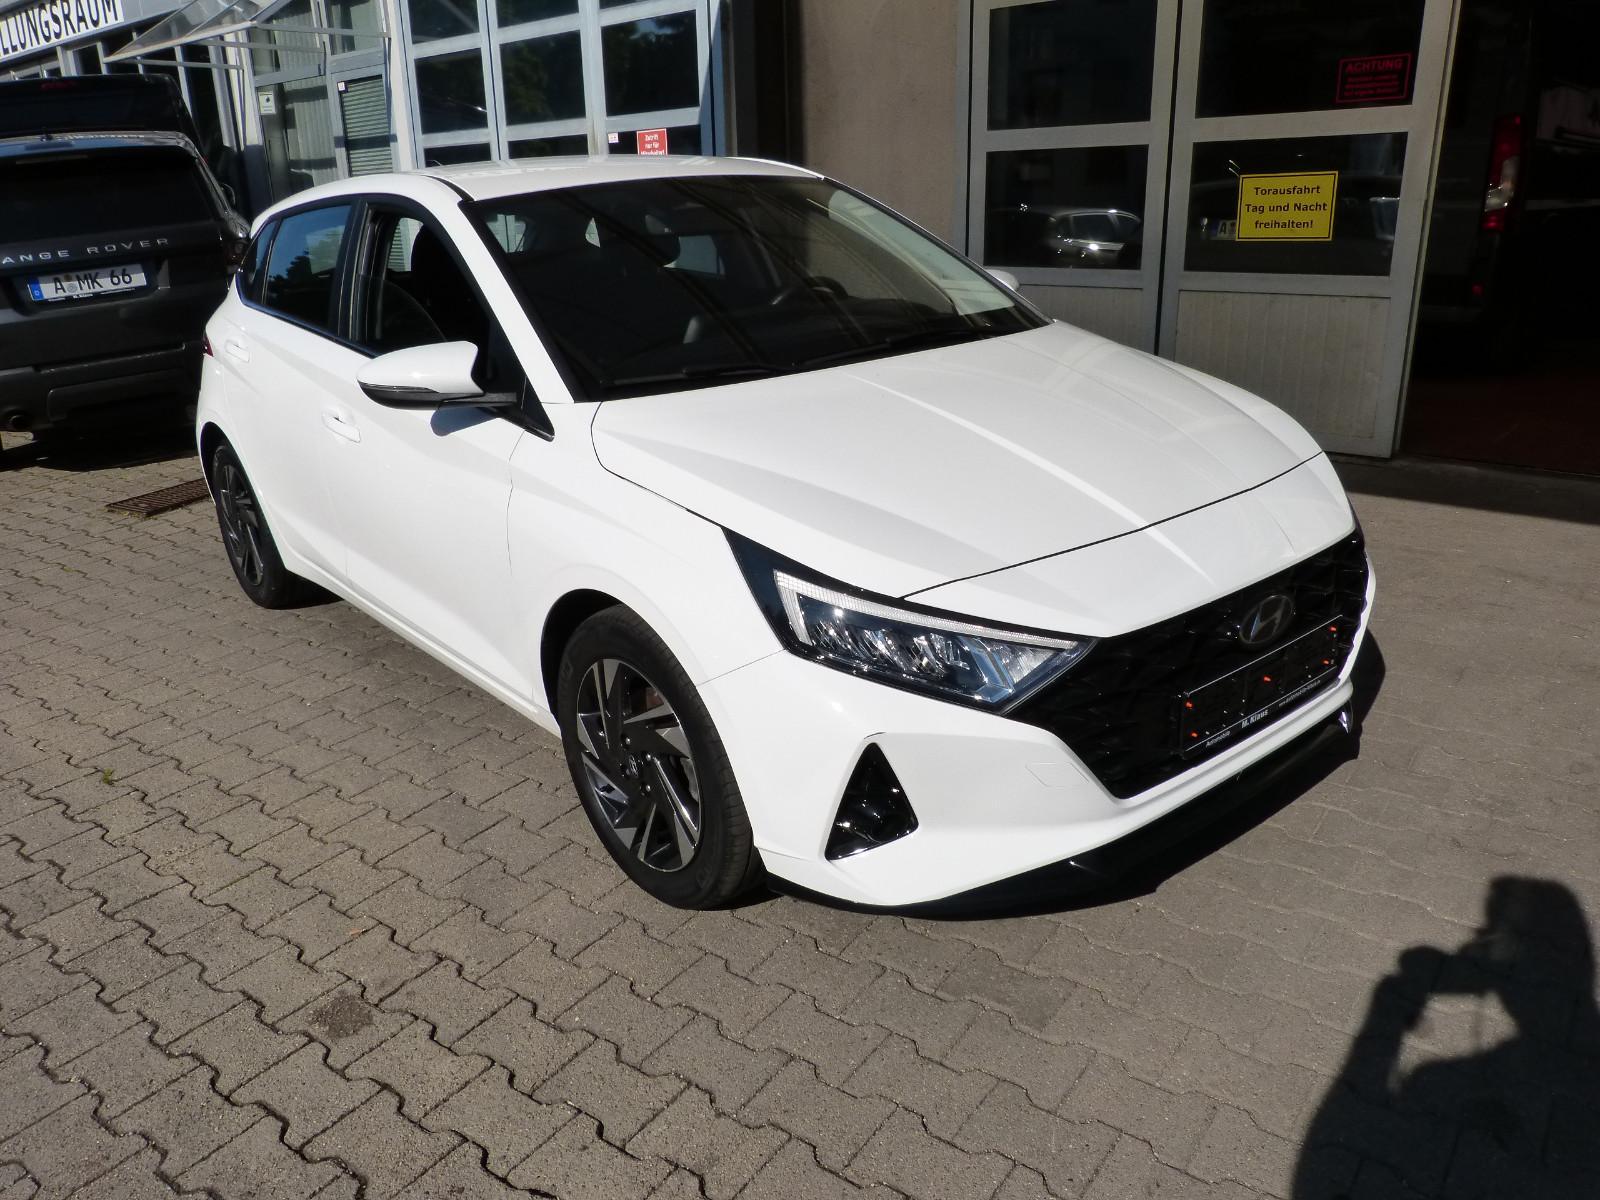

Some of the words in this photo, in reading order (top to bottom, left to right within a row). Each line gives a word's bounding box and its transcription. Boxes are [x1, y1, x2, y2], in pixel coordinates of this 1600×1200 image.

[1345, 59, 1403, 73] ACHTUNG
[1254, 185, 1321, 196] Torausfahrt
[1245, 203, 1265, 214] Tag
[1269, 203, 1290, 212] und
[1293, 202, 1328, 212] Nacht
[1254, 219, 1313, 229] freihalten!
[86, 238, 169, 254] ROVER
[53, 277, 66, 294] A
[75, 272, 103, 290] MK
[110, 268, 133, 286] 66
[1250, 709, 1269, 724] Klaus
